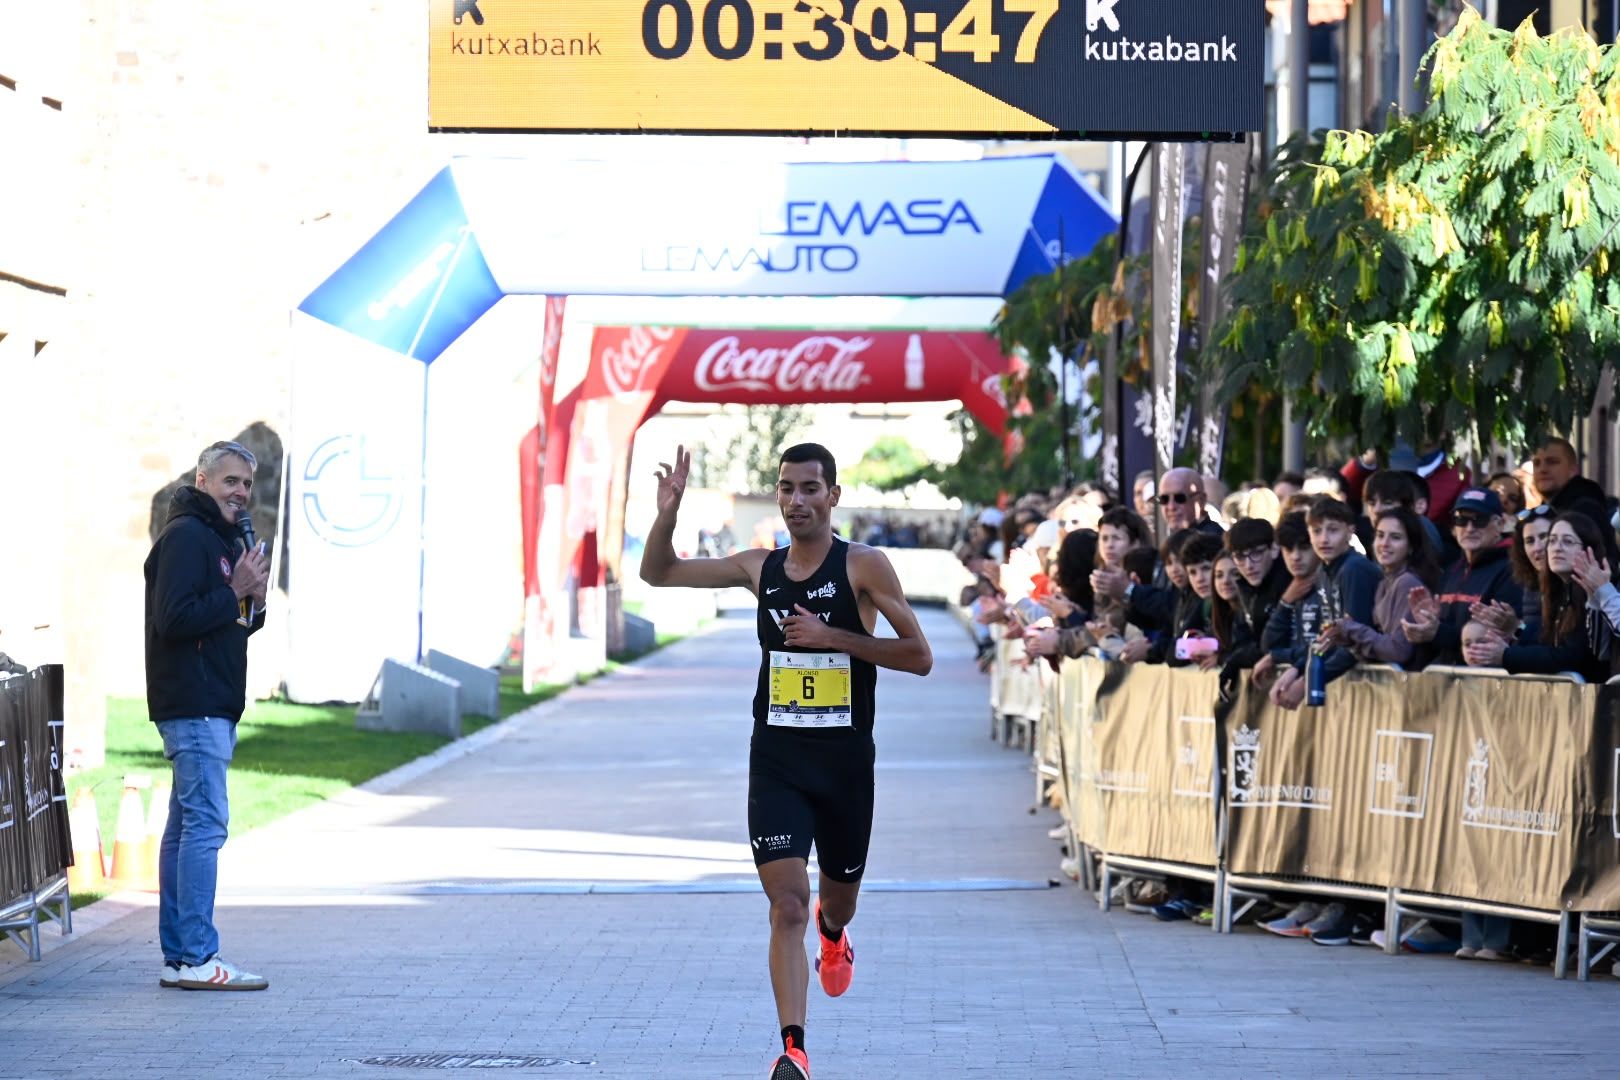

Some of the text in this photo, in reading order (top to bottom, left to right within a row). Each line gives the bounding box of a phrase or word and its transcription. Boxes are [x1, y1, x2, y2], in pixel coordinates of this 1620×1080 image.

[451, 32, 602, 56] kutxabank
[641, 0, 1060, 62] 00:30:47
[1085, 35, 1237, 62] kutxabank
[760, 200, 982, 236] LEMASA
[642, 245, 858, 272] LEMAUTO
[694, 336, 874, 391] Coca-Cola
[807, 581, 837, 600] be plus
[803, 676, 815, 699] 6
